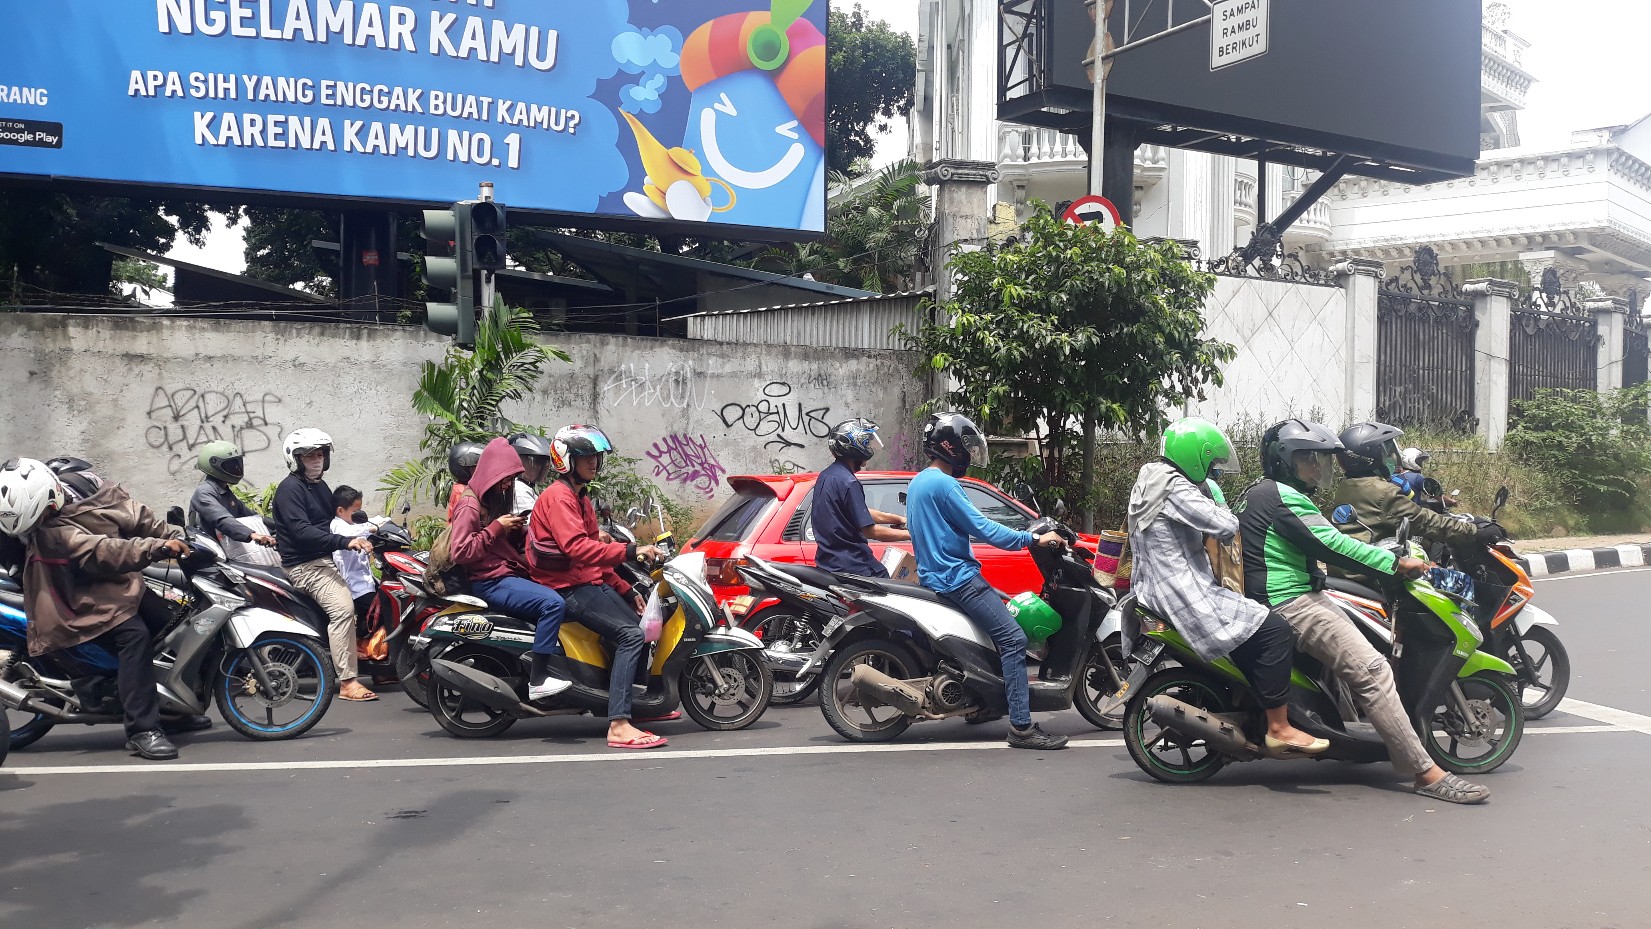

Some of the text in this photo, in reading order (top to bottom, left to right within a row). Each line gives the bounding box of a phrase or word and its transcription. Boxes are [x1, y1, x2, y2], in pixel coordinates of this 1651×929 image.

[157, 0, 558, 71] NGELAMAR KAMU
[1218, 33, 1260, 57] BERIKUT
[1222, 16, 1258, 39] RAMBU
[128, 70, 580, 134] APA SIH YANG ENGGAK BUAT KAMU?
[35, 131, 59, 145] Play
[194, 111, 520, 169] KARENA KAMU NO.1
